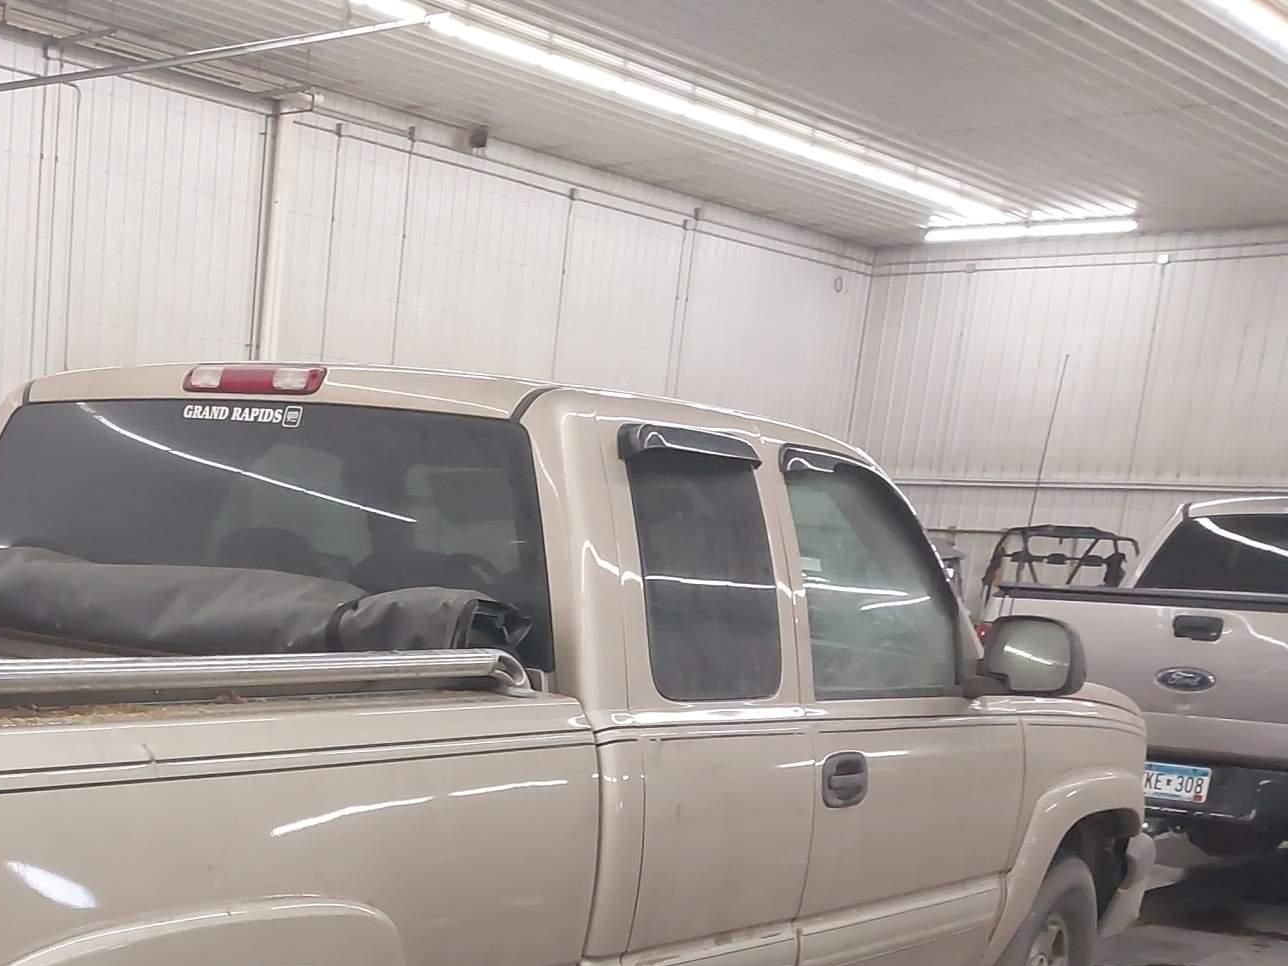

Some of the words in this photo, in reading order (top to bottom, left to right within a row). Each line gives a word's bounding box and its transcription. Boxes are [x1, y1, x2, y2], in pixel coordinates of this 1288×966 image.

[183, 405, 229, 420] GRAND
[230, 407, 283, 423] RAPIDS
[1143, 771, 1163, 790] KE
[1174, 775, 1204, 794] 308
